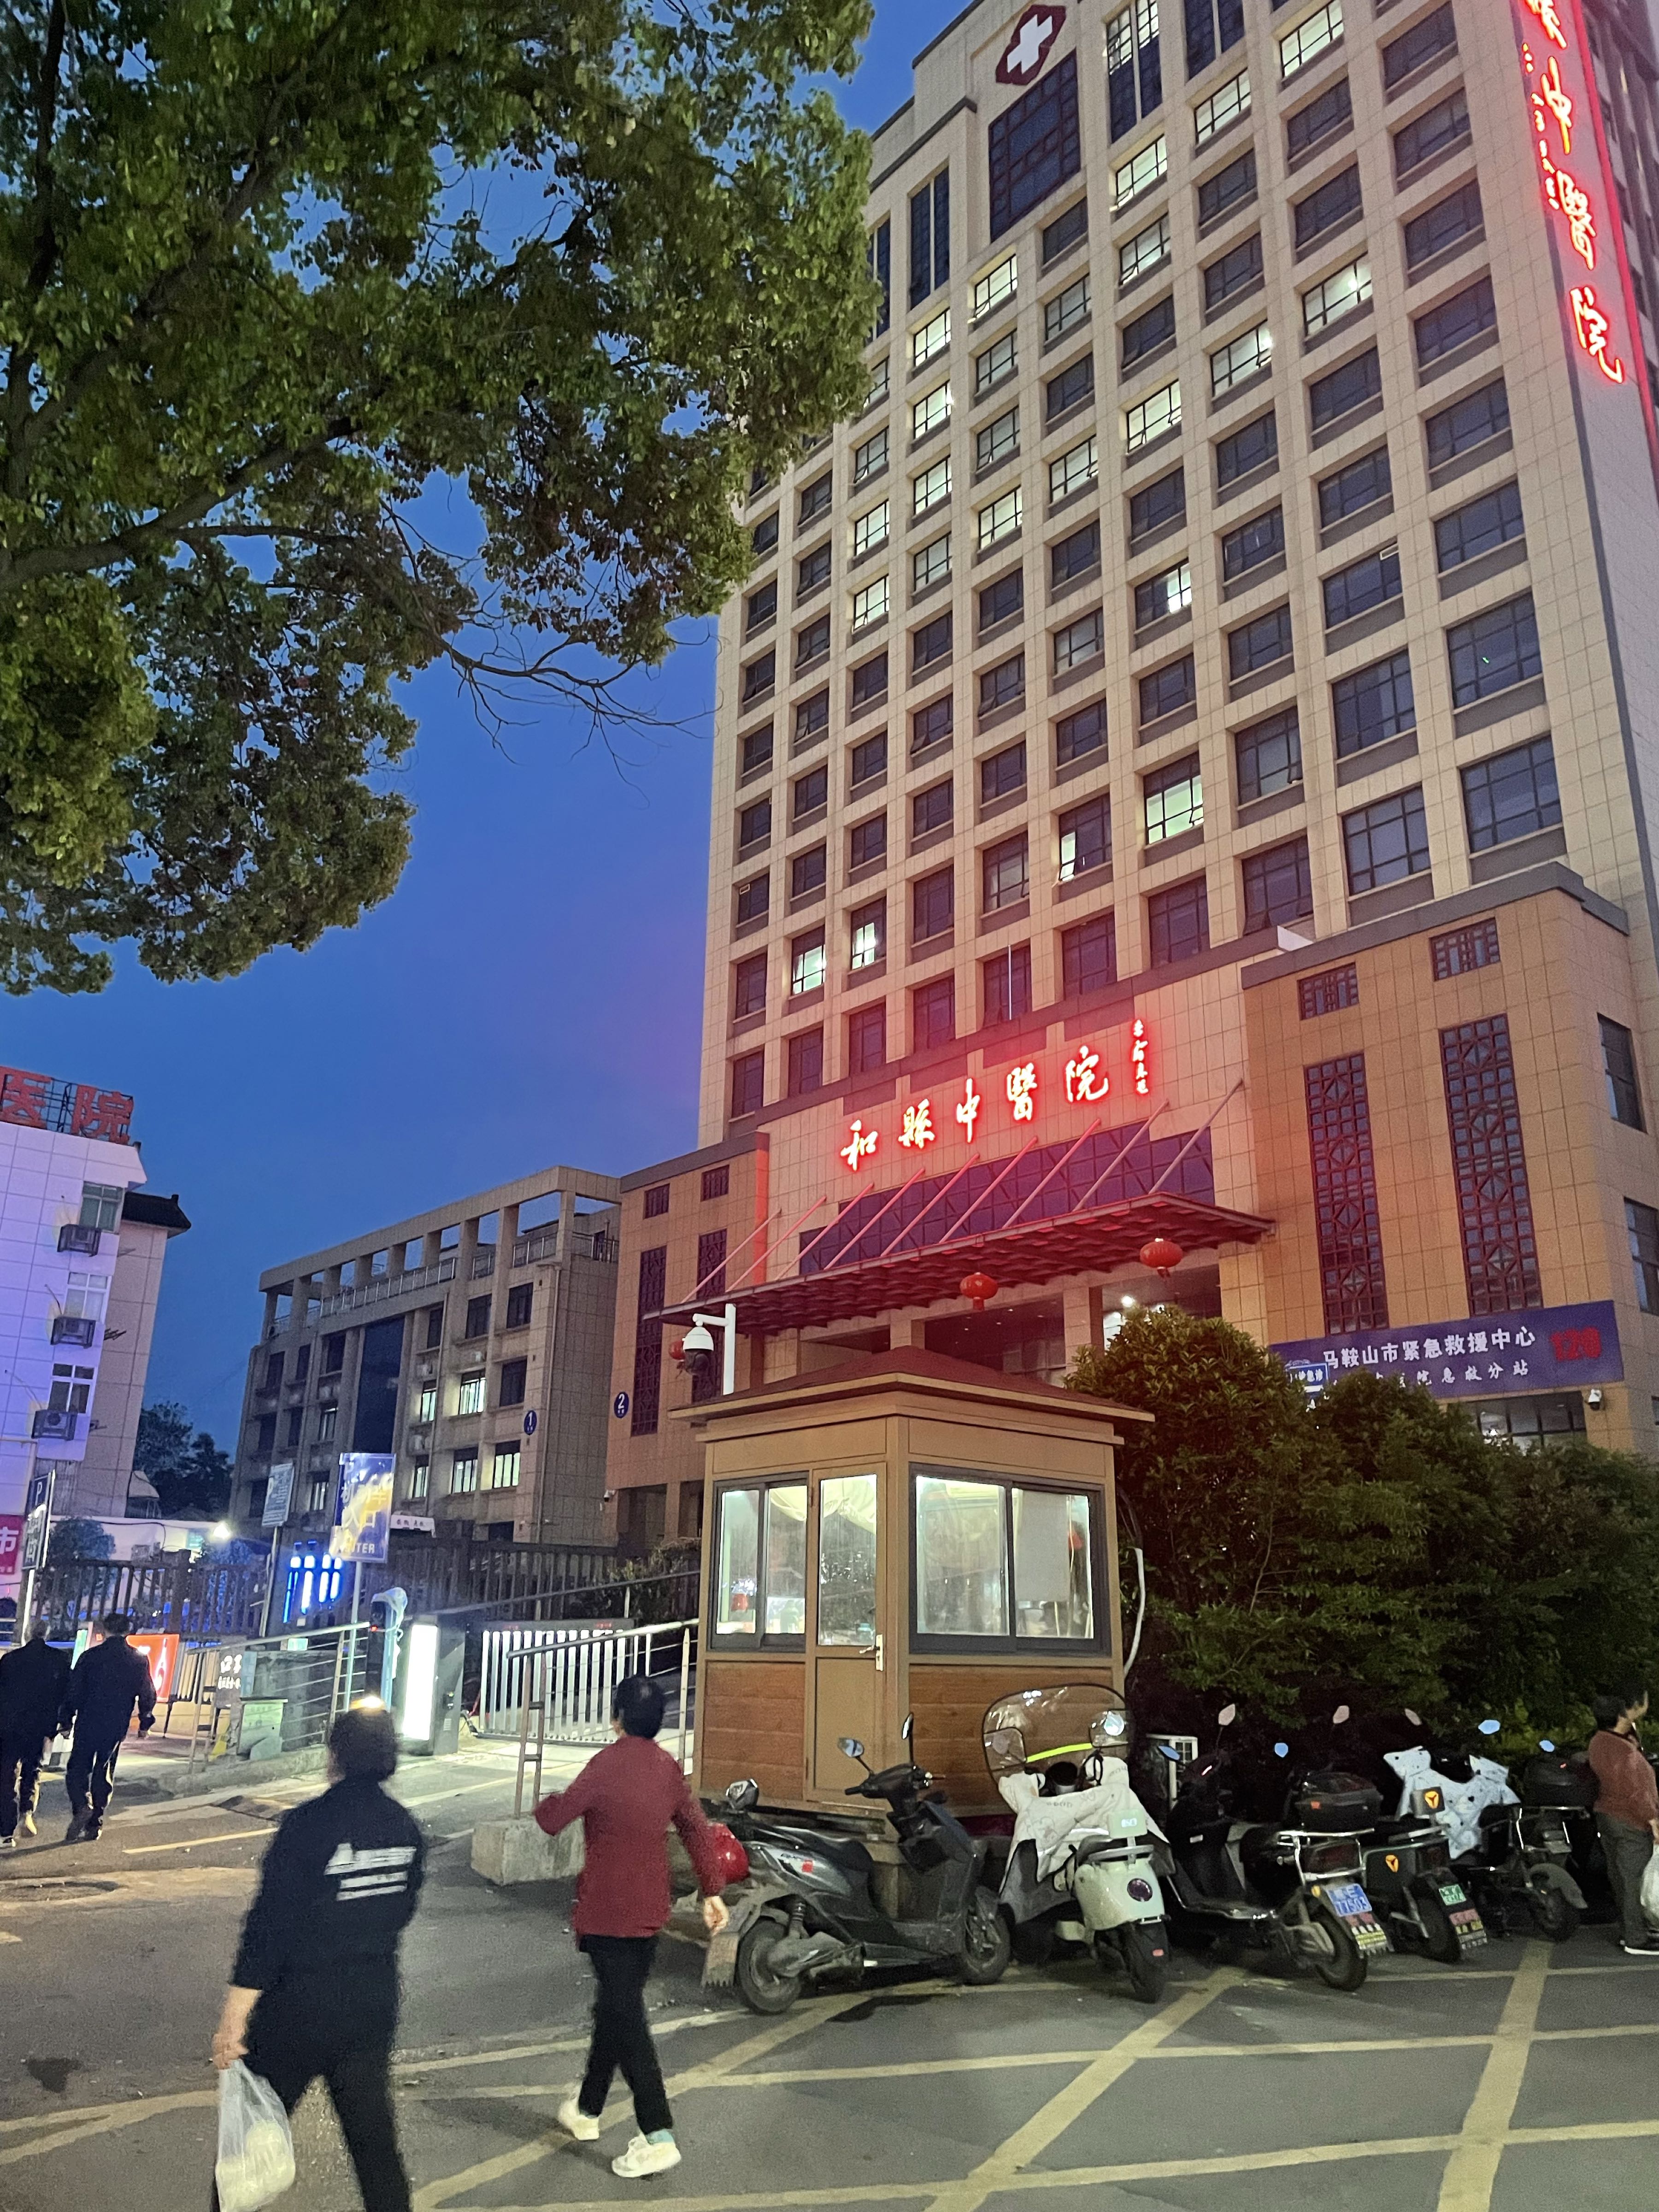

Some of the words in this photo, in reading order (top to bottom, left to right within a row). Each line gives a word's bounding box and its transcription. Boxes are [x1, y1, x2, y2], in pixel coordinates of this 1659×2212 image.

[0, 1066, 134, 1145] 医院
[1324, 1326, 1536, 1369] 马鞍山市紧急救援中心
[1550, 1327, 1602, 1362] 120
[618, 1393, 625, 1409] 2
[529, 1412, 533, 1426] 1
[35, 1481, 43, 1506] P
[348, 1542, 375, 1554] TER
